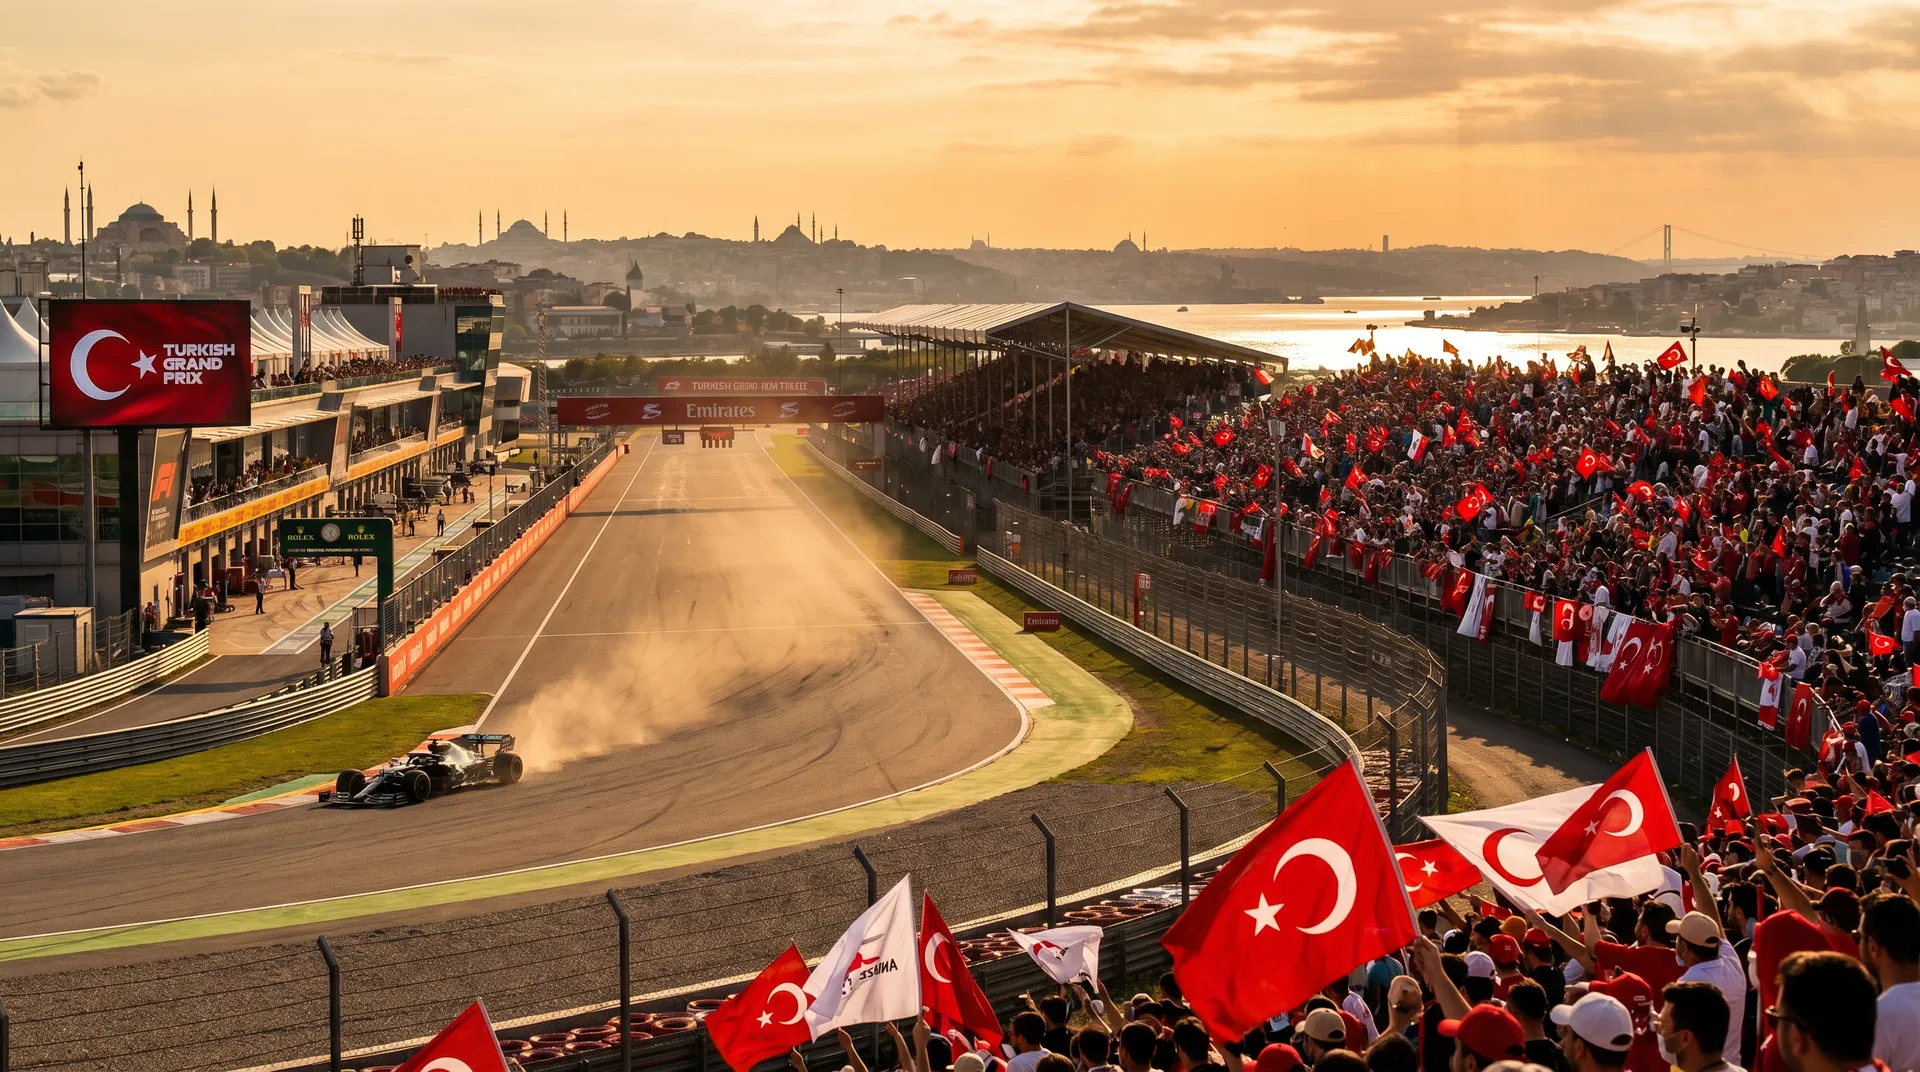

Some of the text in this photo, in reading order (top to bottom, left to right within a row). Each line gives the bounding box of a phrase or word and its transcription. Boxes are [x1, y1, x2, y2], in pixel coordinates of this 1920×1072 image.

[163, 344, 235, 356] TURKISH
[163, 358, 223, 370] GRAND
[163, 372, 203, 385] PRIX
[686, 403, 756, 418] Emirates
[1027, 617, 1059, 625] Emirates
